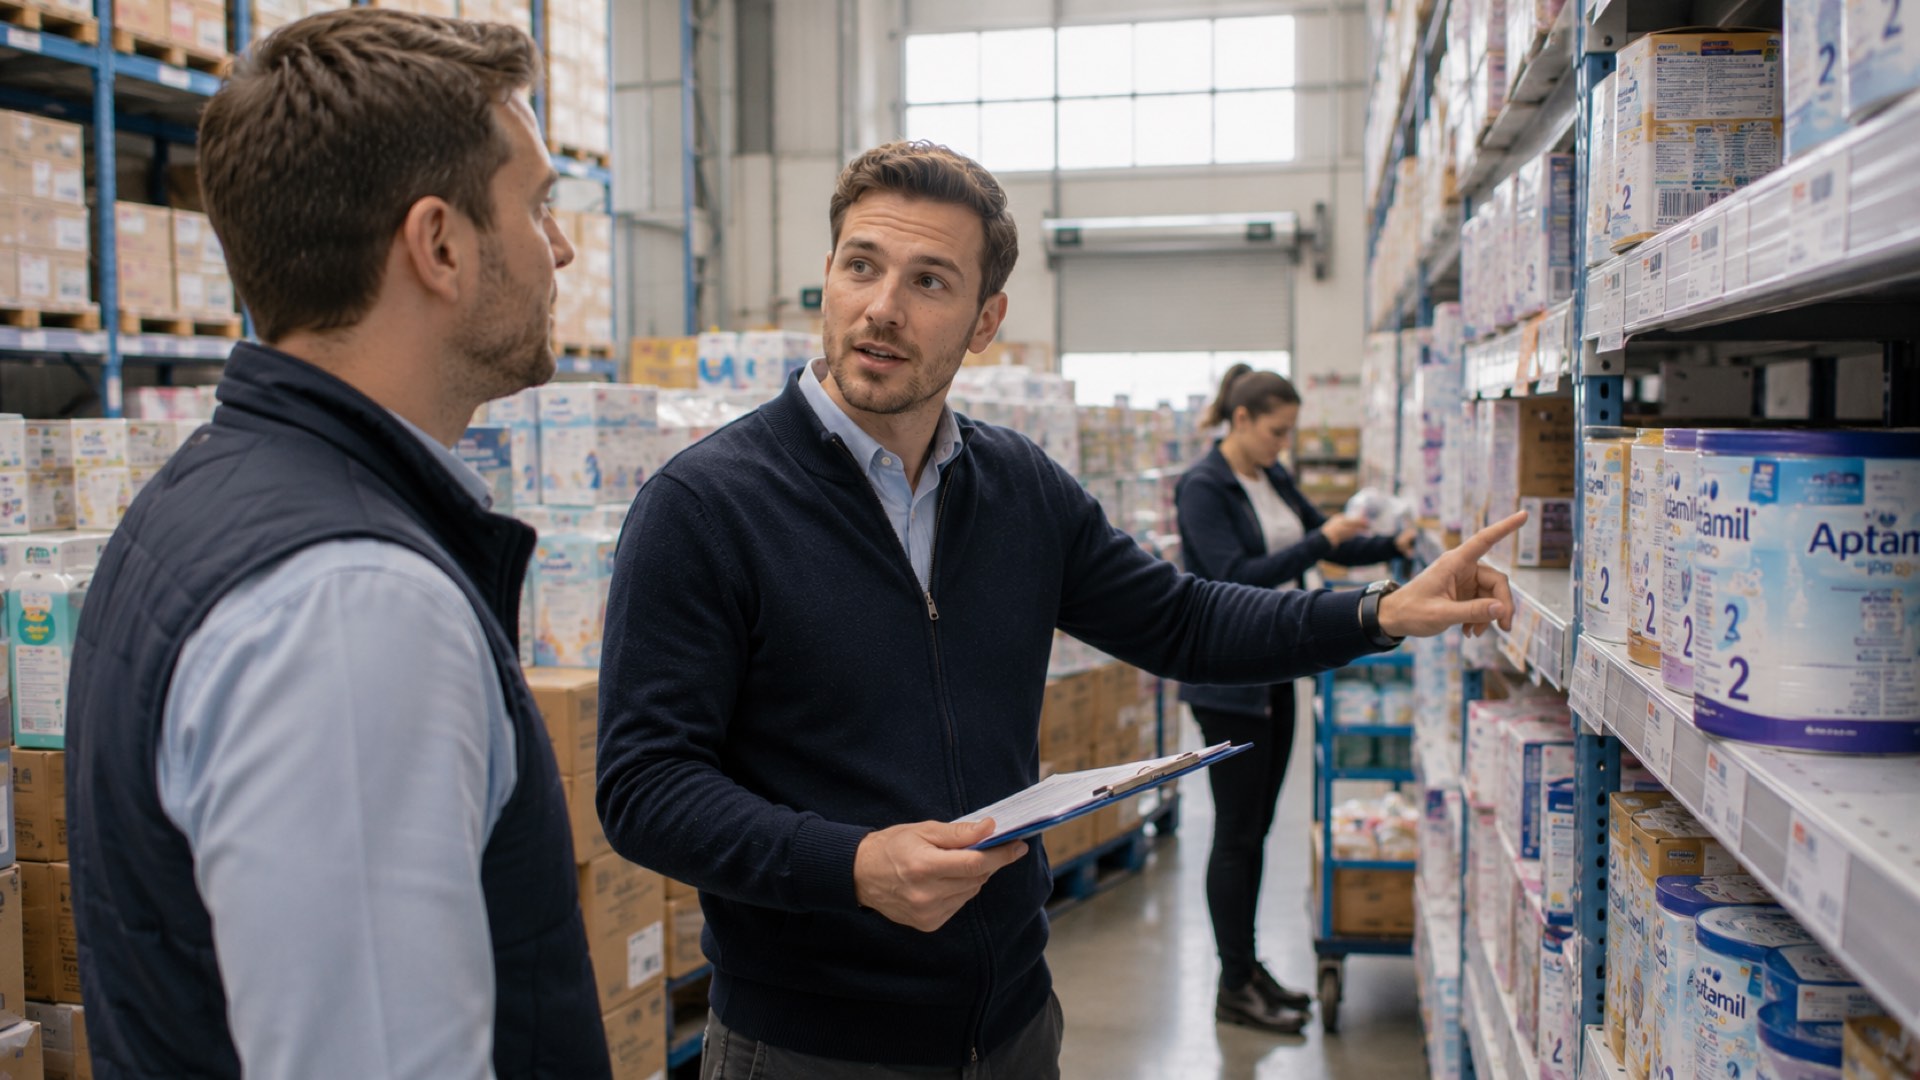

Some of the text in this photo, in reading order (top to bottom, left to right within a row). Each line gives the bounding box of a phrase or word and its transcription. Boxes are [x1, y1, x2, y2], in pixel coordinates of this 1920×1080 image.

[1818, 42, 1836, 86] 2
[1622, 184, 1633, 211] 2
[1600, 566, 1609, 605] 2
[1646, 591, 1656, 635] 2
[1683, 615, 1693, 658] 2
[1727, 656, 1750, 702] 2
